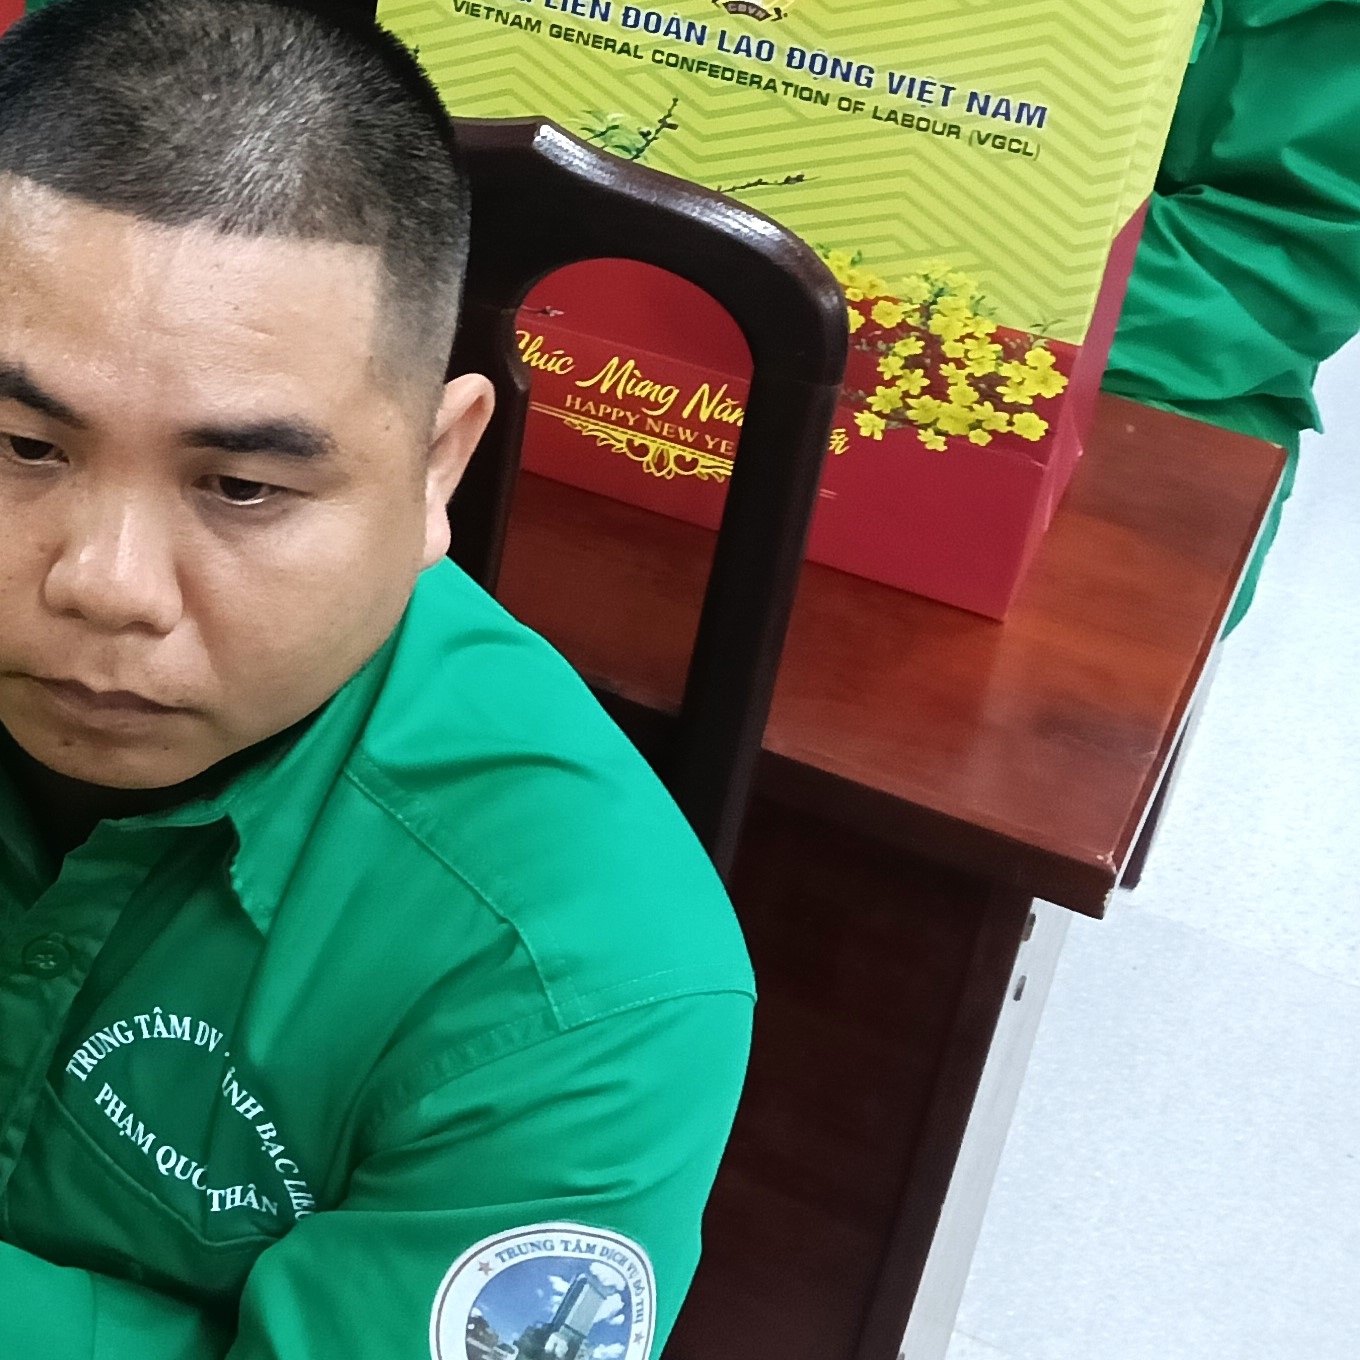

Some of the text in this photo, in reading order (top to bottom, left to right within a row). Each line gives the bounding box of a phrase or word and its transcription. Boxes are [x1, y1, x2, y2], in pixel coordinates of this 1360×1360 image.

[548, 22, 644, 60] GENERAL
[651, 48, 830, 106] CONFEDERATION
[837, 96, 865, 115] OF
[872, 105, 962, 140] LABOUR
[969, 128, 1041, 161] (VGCL)
[621, 6, 707, 46] ĐOÀN
[718, 29, 774, 63] LAO
[786, 46, 876, 89] ĐỘNG
[888, 70, 957, 109] VIỆT
[966, 90, 1048, 129] NAM
[564, 394, 699, 446] HAPPY NEW
[575, 356, 680, 417] Mừng
[66, 1006, 299, 1175] TRUNG TÂM BẠC
[95, 1082, 157, 1156] PHẠM
[495, 1238, 555, 1264] TRUNG
[560, 1238, 597, 1256] TÂM
[599, 1245, 630, 1268] DỊCH
